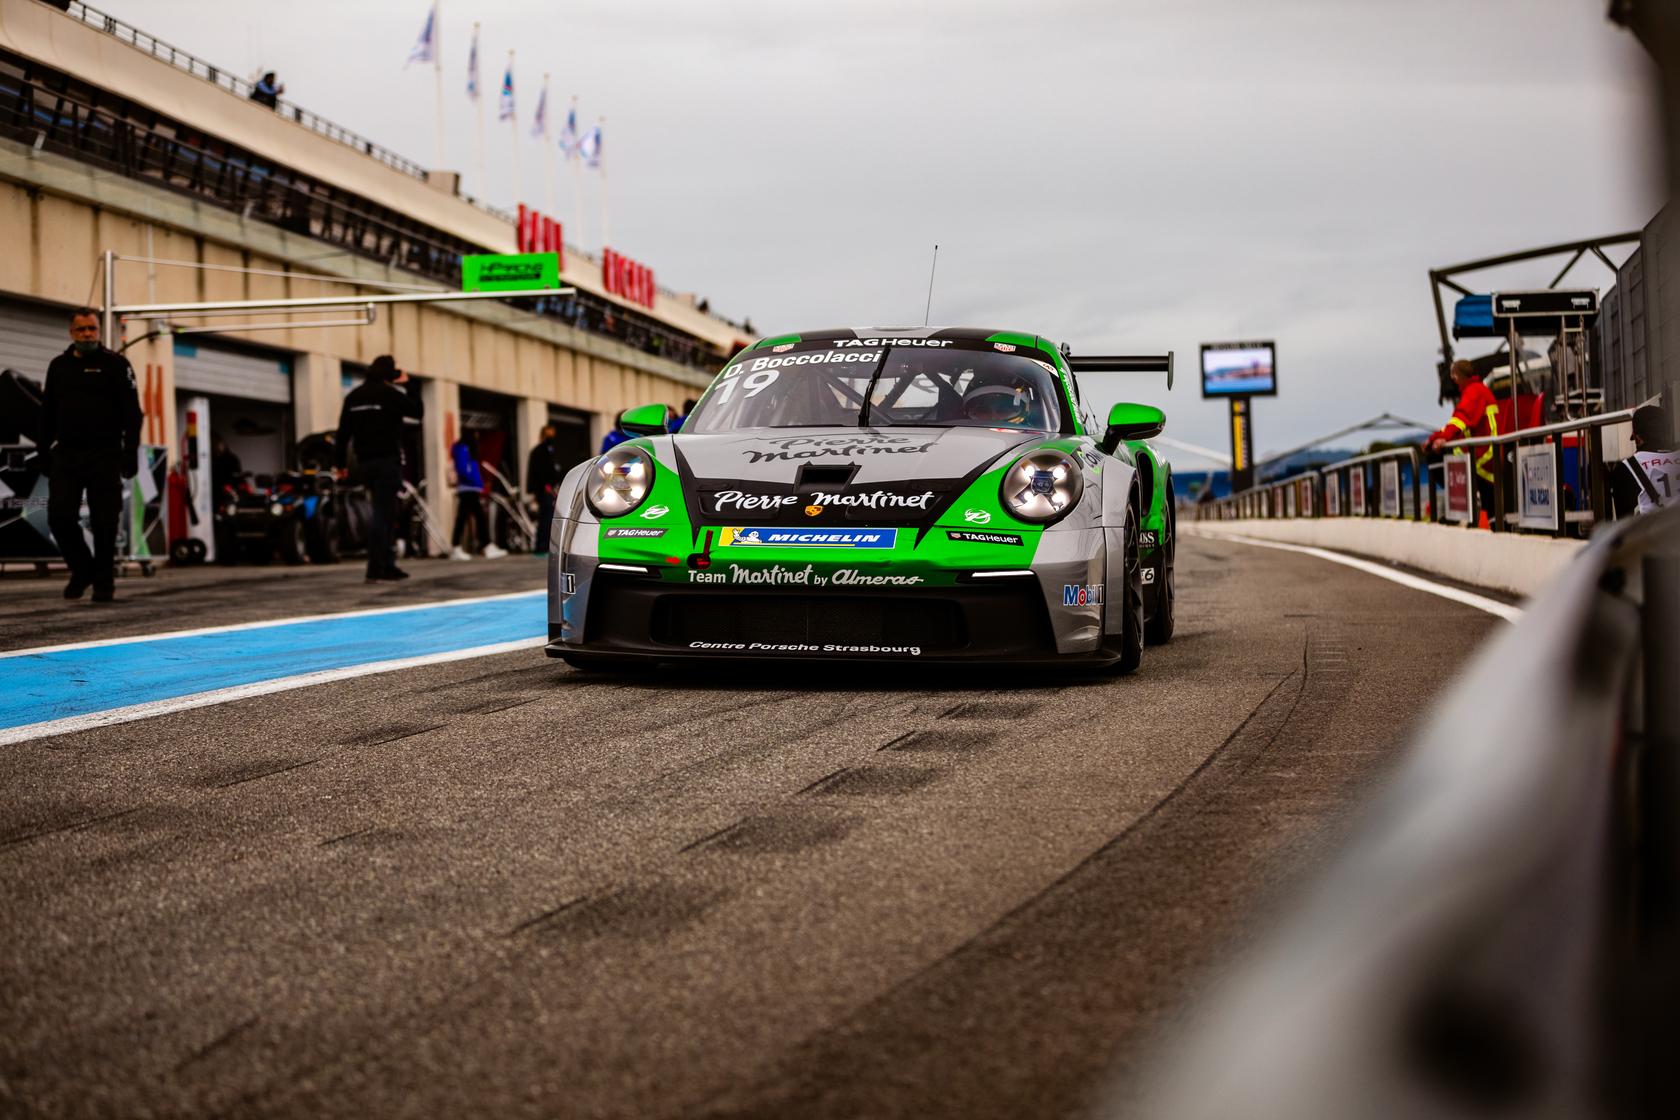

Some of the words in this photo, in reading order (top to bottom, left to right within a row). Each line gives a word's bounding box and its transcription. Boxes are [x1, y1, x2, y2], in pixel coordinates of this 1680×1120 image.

[723, 364, 744, 379] D.
[751, 351, 882, 371] Boccolacci
[714, 370, 780, 405] 19
[743, 442, 938, 463] Martinet
[768, 436, 909, 449] Pierre
[714, 490, 798, 511] Pierre
[811, 491, 935, 509] Martinet
[768, 534, 880, 543] MICHELIN
[688, 570, 726, 583] Team
[729, 564, 814, 585] Martinet
[814, 575, 828, 586] by
[831, 569, 924, 585] Almeras
[689, 641, 745, 649] Centre
[749, 642, 819, 651] Porsche
[823, 644, 920, 655] Strasbourg
